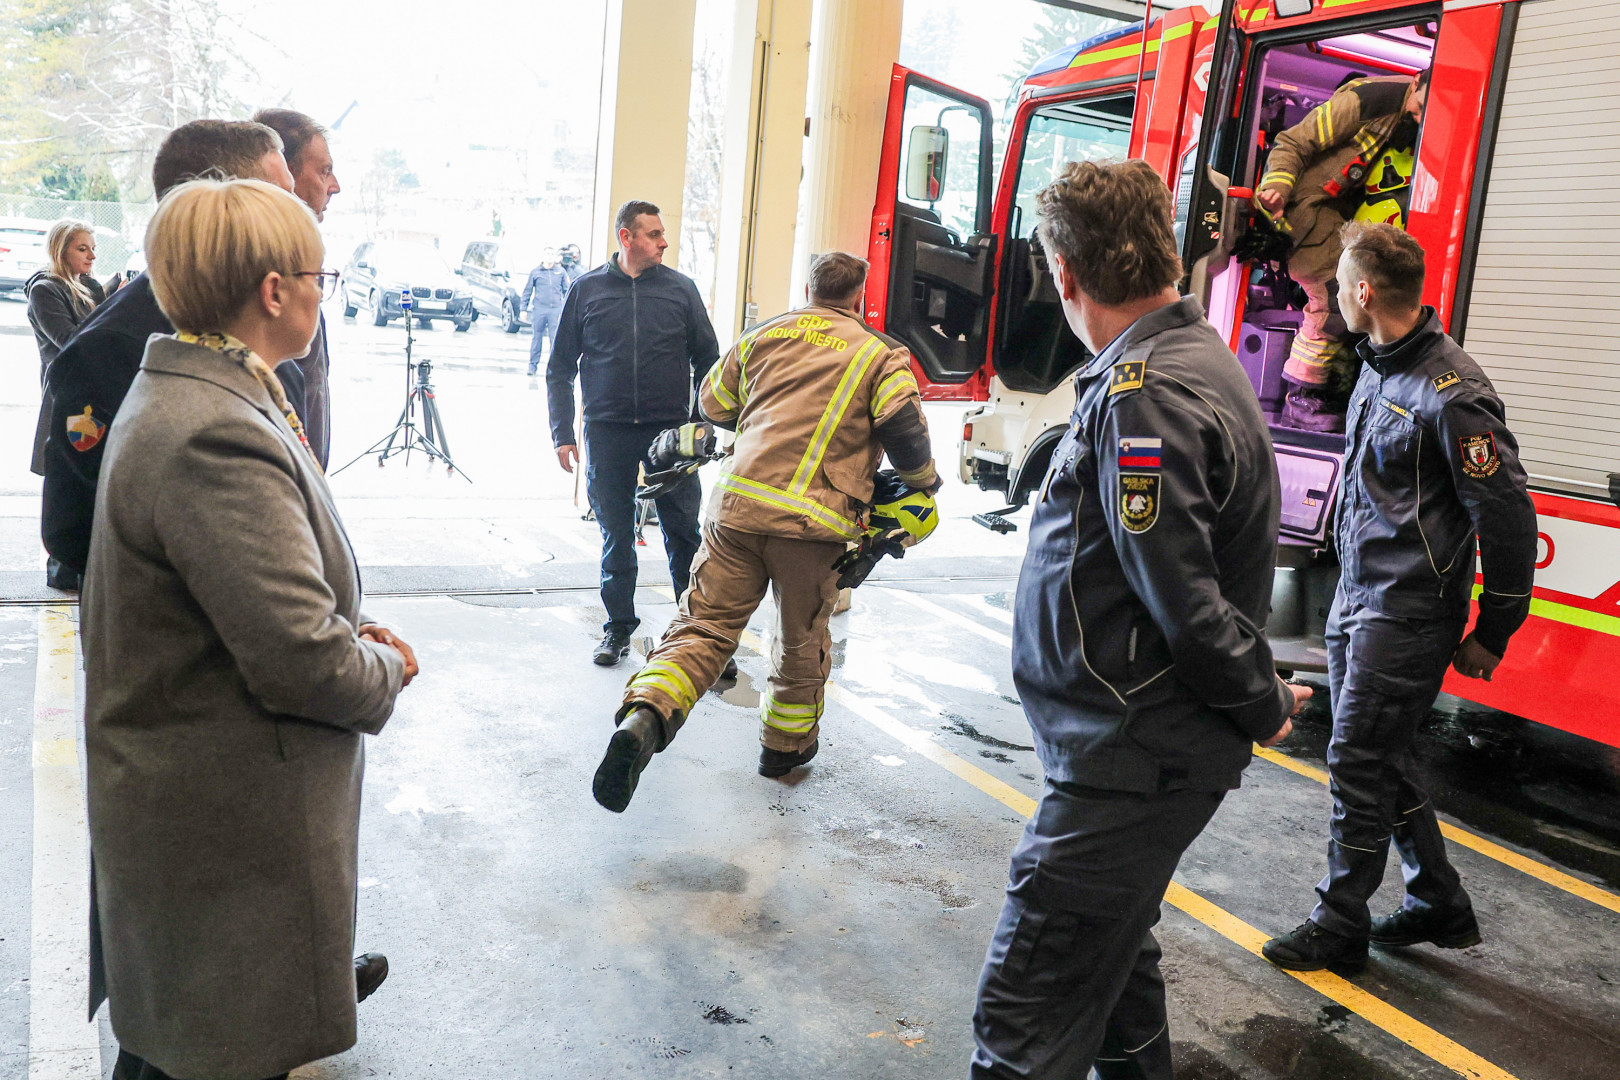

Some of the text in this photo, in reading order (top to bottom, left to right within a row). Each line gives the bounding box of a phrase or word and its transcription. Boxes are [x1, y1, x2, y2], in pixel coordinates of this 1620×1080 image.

[764, 328, 848, 352] NOVO MESTO
[1465, 456, 1495, 471] NOVO MESTO
[1486, 461, 1501, 476] MESTO
